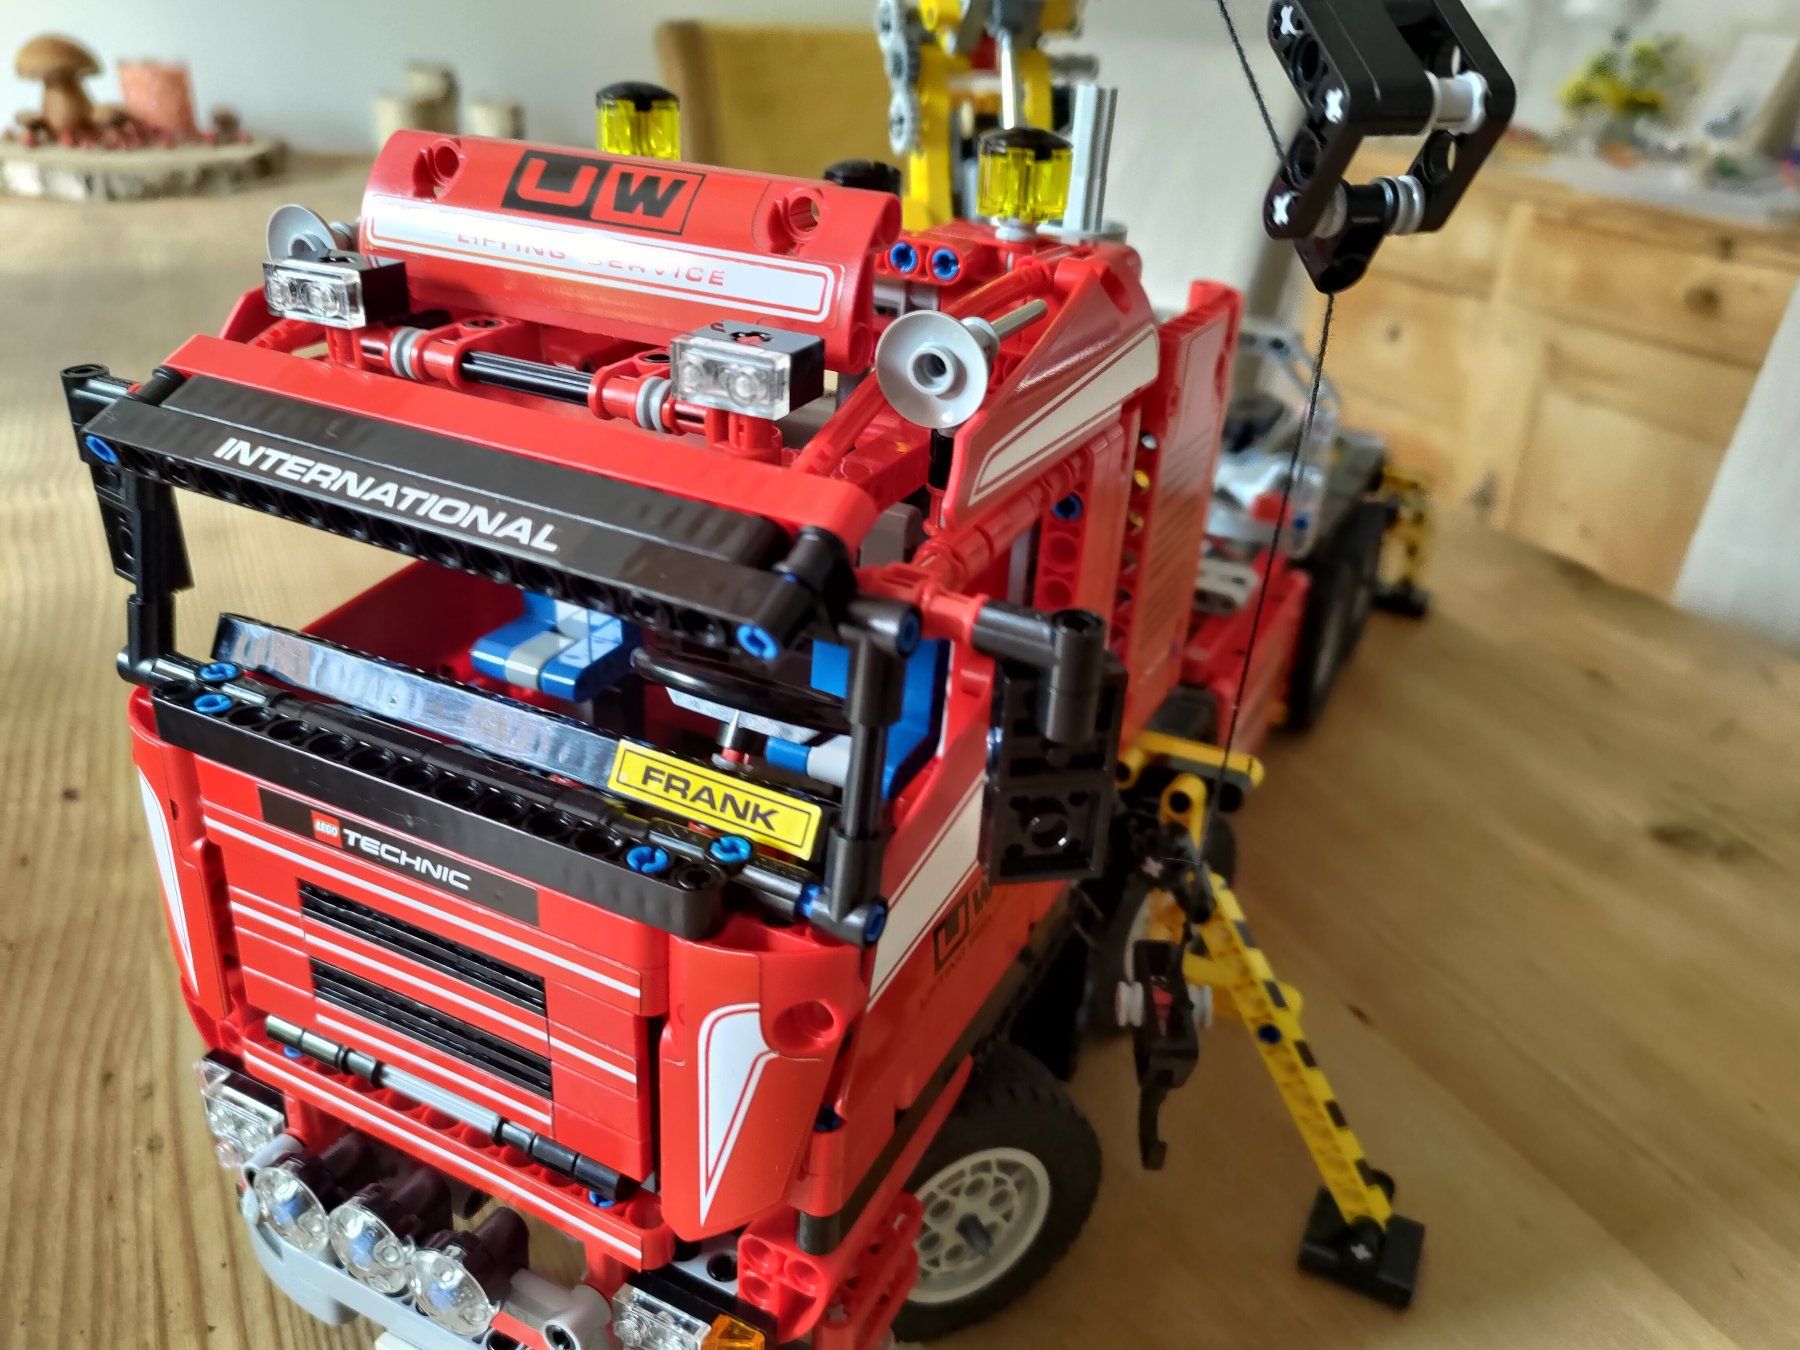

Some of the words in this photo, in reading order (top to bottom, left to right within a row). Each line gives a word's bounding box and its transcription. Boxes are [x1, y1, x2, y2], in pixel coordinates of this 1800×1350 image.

[586, 254, 727, 287] ERICE
[212, 436, 560, 552] INTERNATIONAL
[641, 765, 778, 831] FRANK
[313, 819, 339, 838] LEGO
[343, 828, 473, 891] TECHNIC
